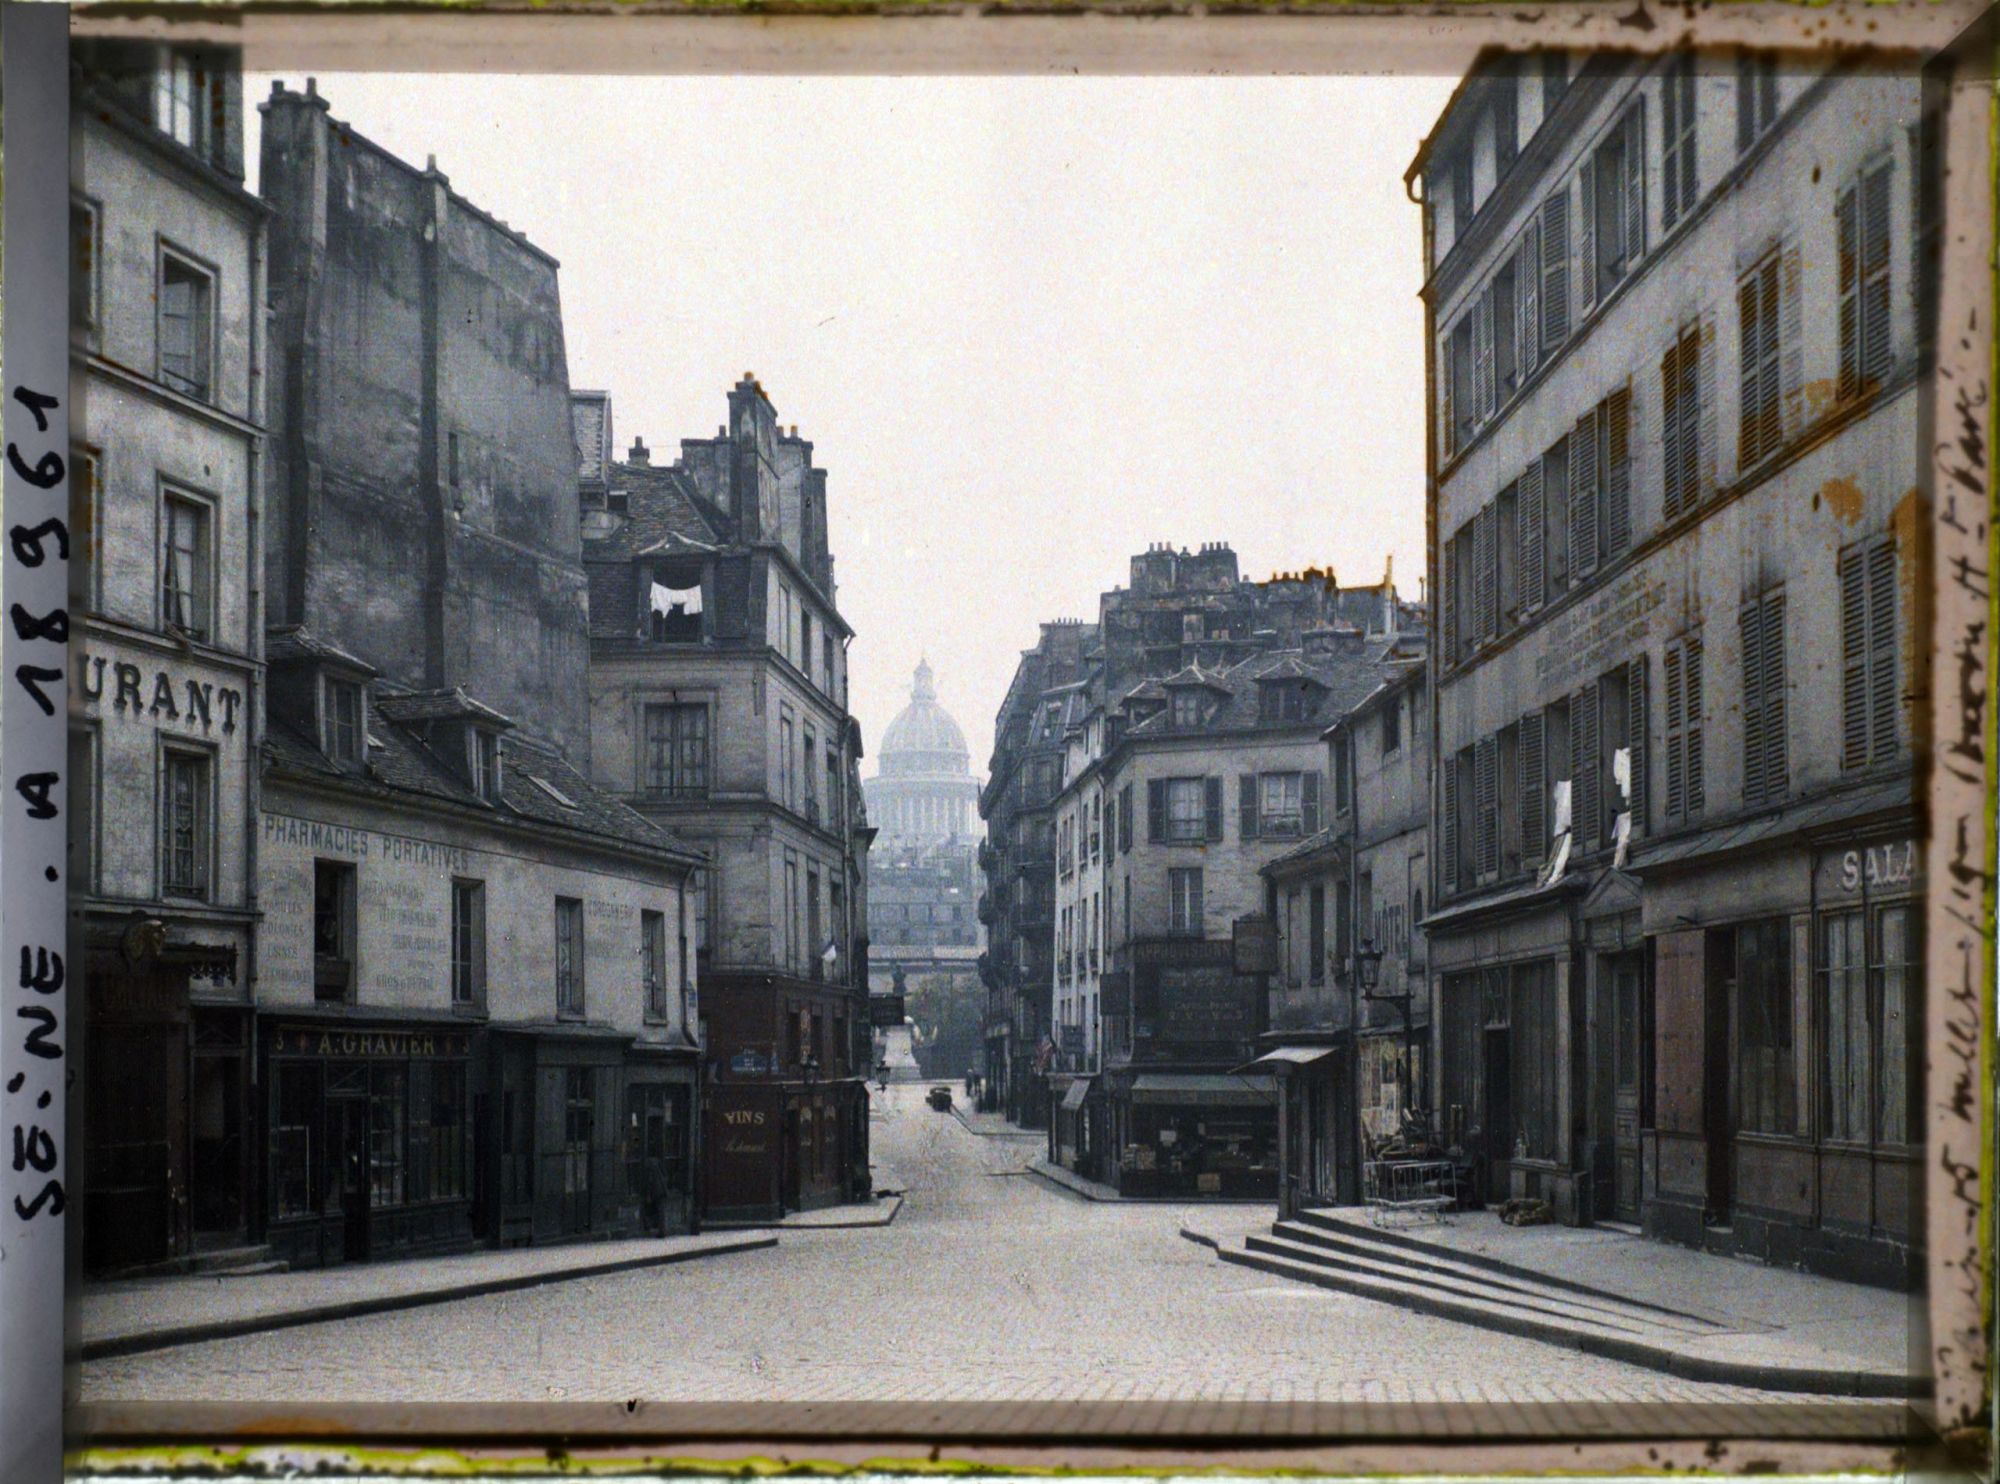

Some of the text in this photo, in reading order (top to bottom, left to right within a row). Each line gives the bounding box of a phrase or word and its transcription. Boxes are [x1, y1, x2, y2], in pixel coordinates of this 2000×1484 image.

[79, 653, 241, 735] URANT
[265, 815, 469, 872] PHARMACIES PORTATIVES
[724, 1110, 765, 1126] VINS
